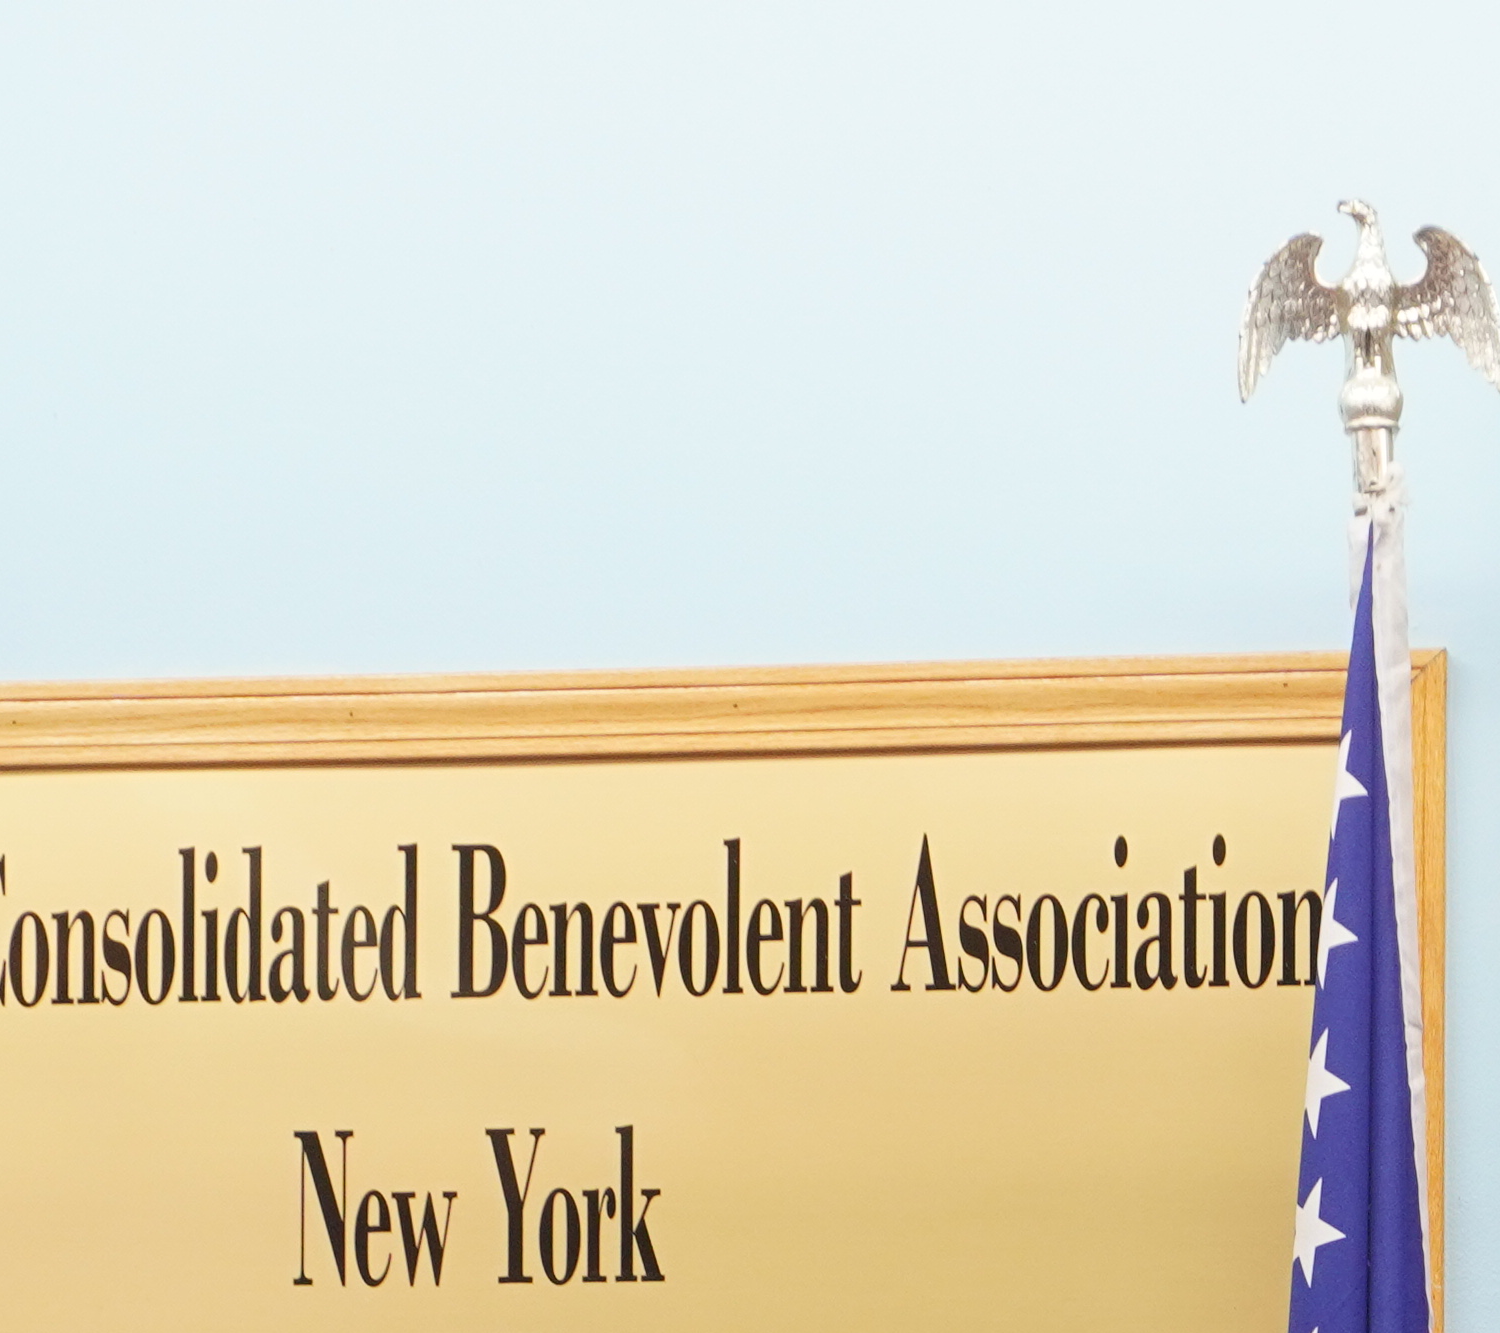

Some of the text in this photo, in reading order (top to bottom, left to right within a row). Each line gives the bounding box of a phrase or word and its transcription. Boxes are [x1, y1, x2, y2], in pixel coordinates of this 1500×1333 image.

[451, 838, 864, 1002] Benevolent
[890, 835, 1323, 995] Association
[293, 1124, 667, 1289] New York
